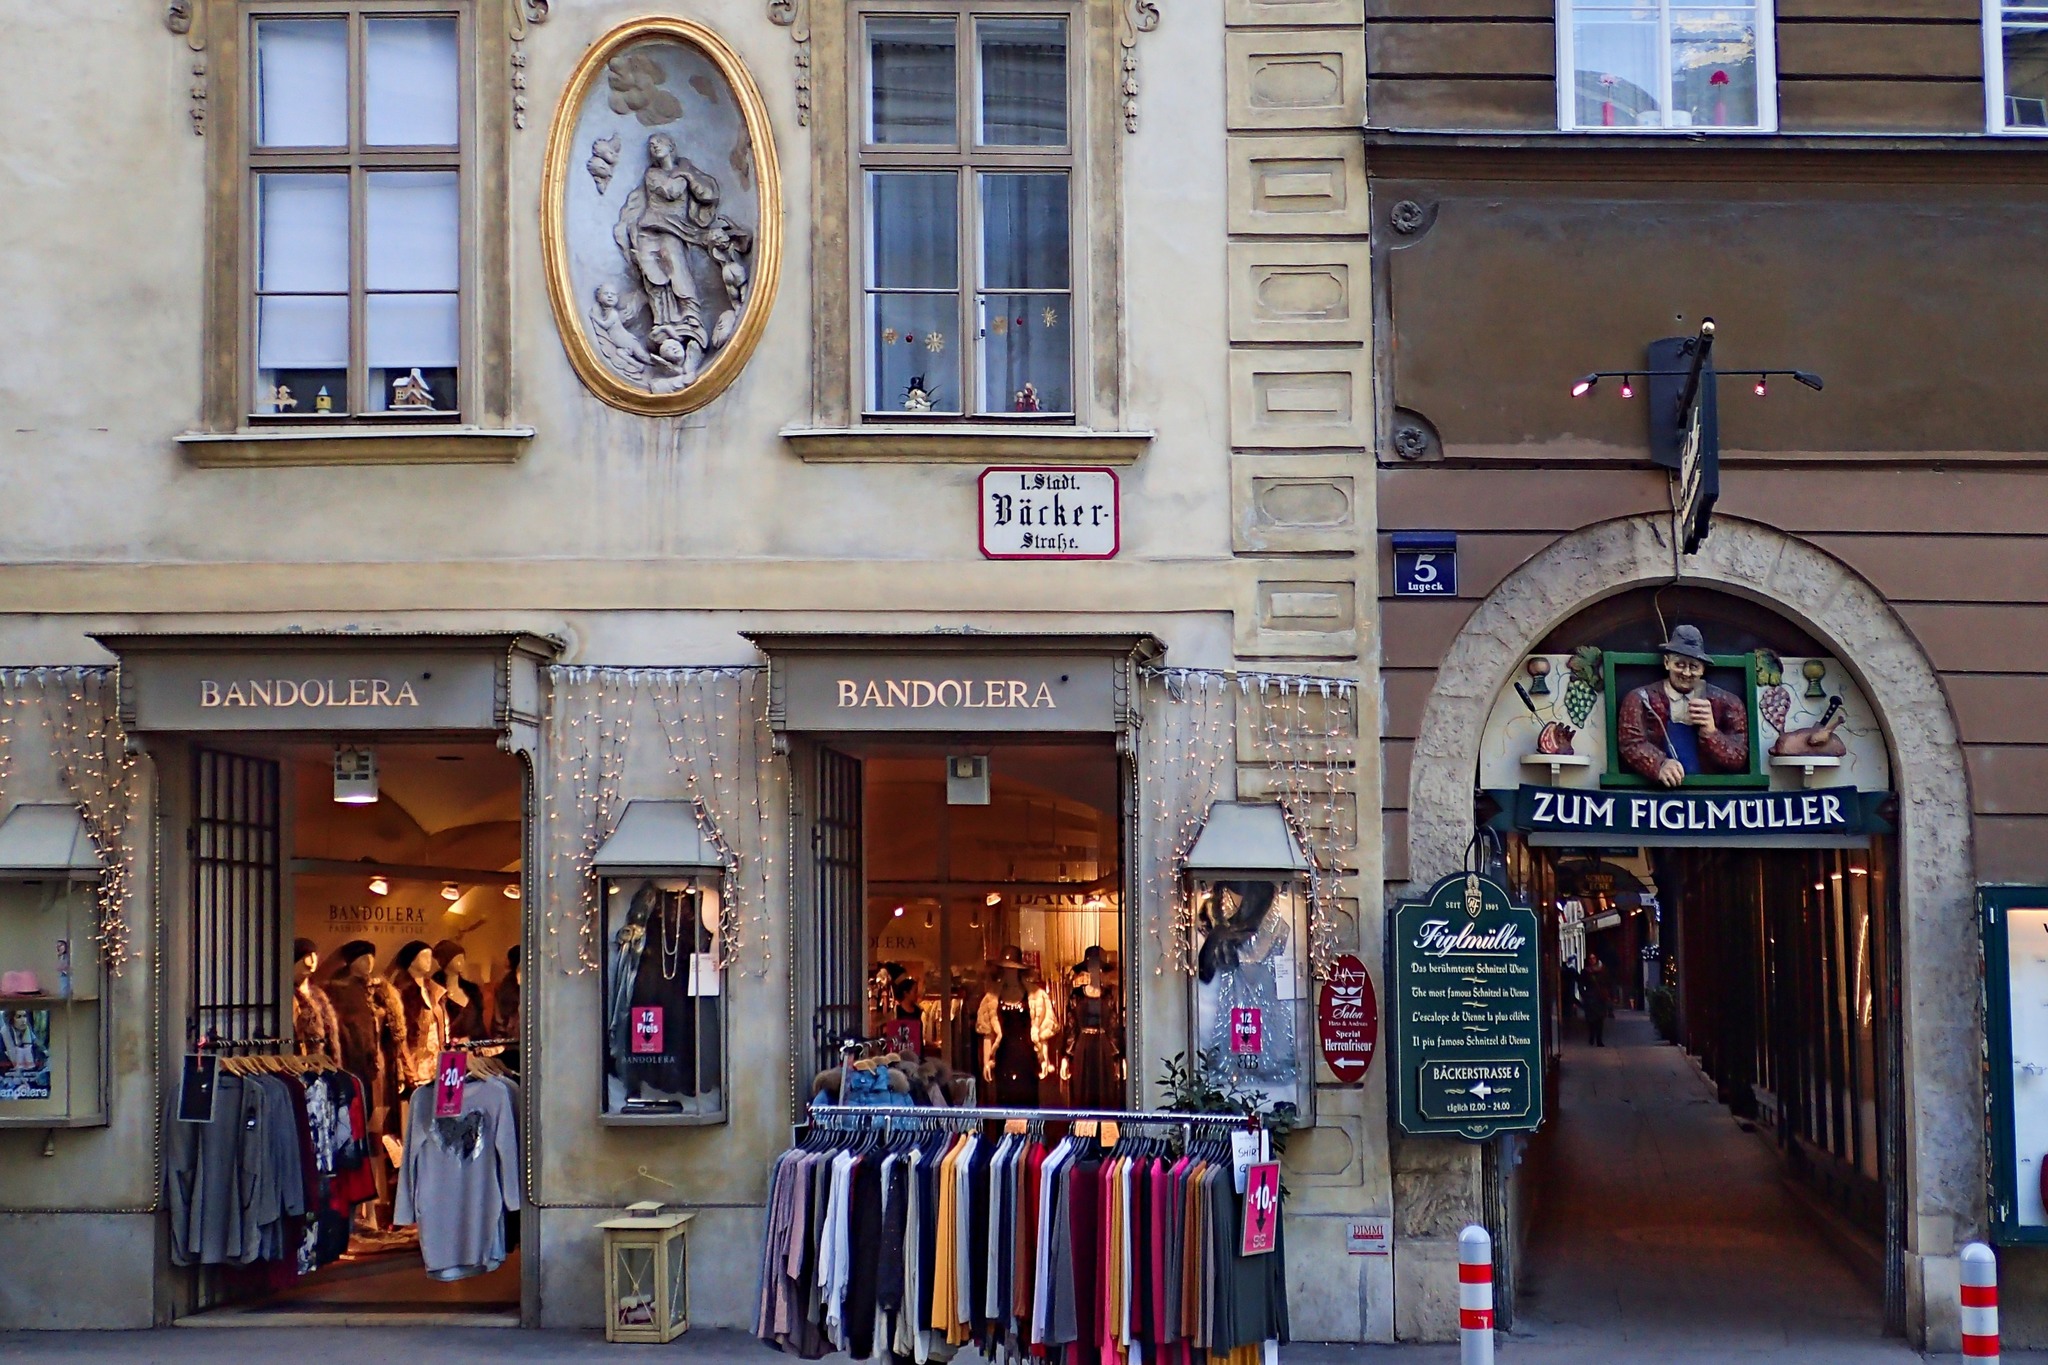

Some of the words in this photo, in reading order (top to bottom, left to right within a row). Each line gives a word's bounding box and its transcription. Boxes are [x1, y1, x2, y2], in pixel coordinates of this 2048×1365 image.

[992, 492, 1109, 527] Bäcker-
[1414, 554, 1437, 582] 5
[1408, 582, 1444, 593] Lugeck
[201, 679, 419, 707] BANDOLERA
[837, 679, 1056, 708] BANDOLERA
[1532, 791, 1615, 827] ZUM
[1630, 794, 1845, 829] FIGLMÜLLER
[1445, 901, 1461, 909] SEIT
[1485, 903, 1499, 911] 1905
[329, 905, 425, 922] BANDOLERA
[1413, 919, 1526, 958] Figlmüller
[1411, 962, 1427, 974] Das
[1429, 962, 1474, 974] berühmteste
[1476, 963, 1508, 974] Schnitzel
[1509, 963, 1529, 974] Wiens
[1411, 987, 1427, 998] The
[1428, 988, 1446, 998] most
[1447, 987, 1471, 999] famous
[1473, 987, 1501, 998] Schnitzel
[1502, 988, 1509, 998] in
[1510, 988, 1529, 998] Vienna
[642, 1011, 654, 1022] 1/2
[1240, 1012, 1252, 1023] 1/2
[1331, 1004, 1364, 1020] Salon
[1412, 1011, 1450, 1025] L'escalope
[1451, 1013, 1460, 1022] de
[1462, 1012, 1485, 1022] Vienne
[1487, 1011, 1494, 1022] la
[1495, 1011, 1508, 1025] plus
[637, 1023, 659, 1033] Preis
[1235, 1023, 1257, 1034] Preis
[1336, 1030, 1361, 1038] Spezial
[1325, 1038, 1372, 1052] Herrenfriseur
[1412, 1036, 1420, 1047] Il
[1437, 1036, 1464, 1048] famoso
[1466, 1035, 1499, 1046] Schnitzel
[1500, 1035, 1507, 1046] di
[1508, 1035, 1531, 1045] Vienna
[1433, 1065, 1512, 1080] BÄCKERSTRASSE
[1514, 1067, 1520, 1078] 6
[1446, 1103, 1468, 1113] täglich
[1469, 1102, 1486, 1111] 12.00
[1493, 1102, 1510, 1111] 24.00
